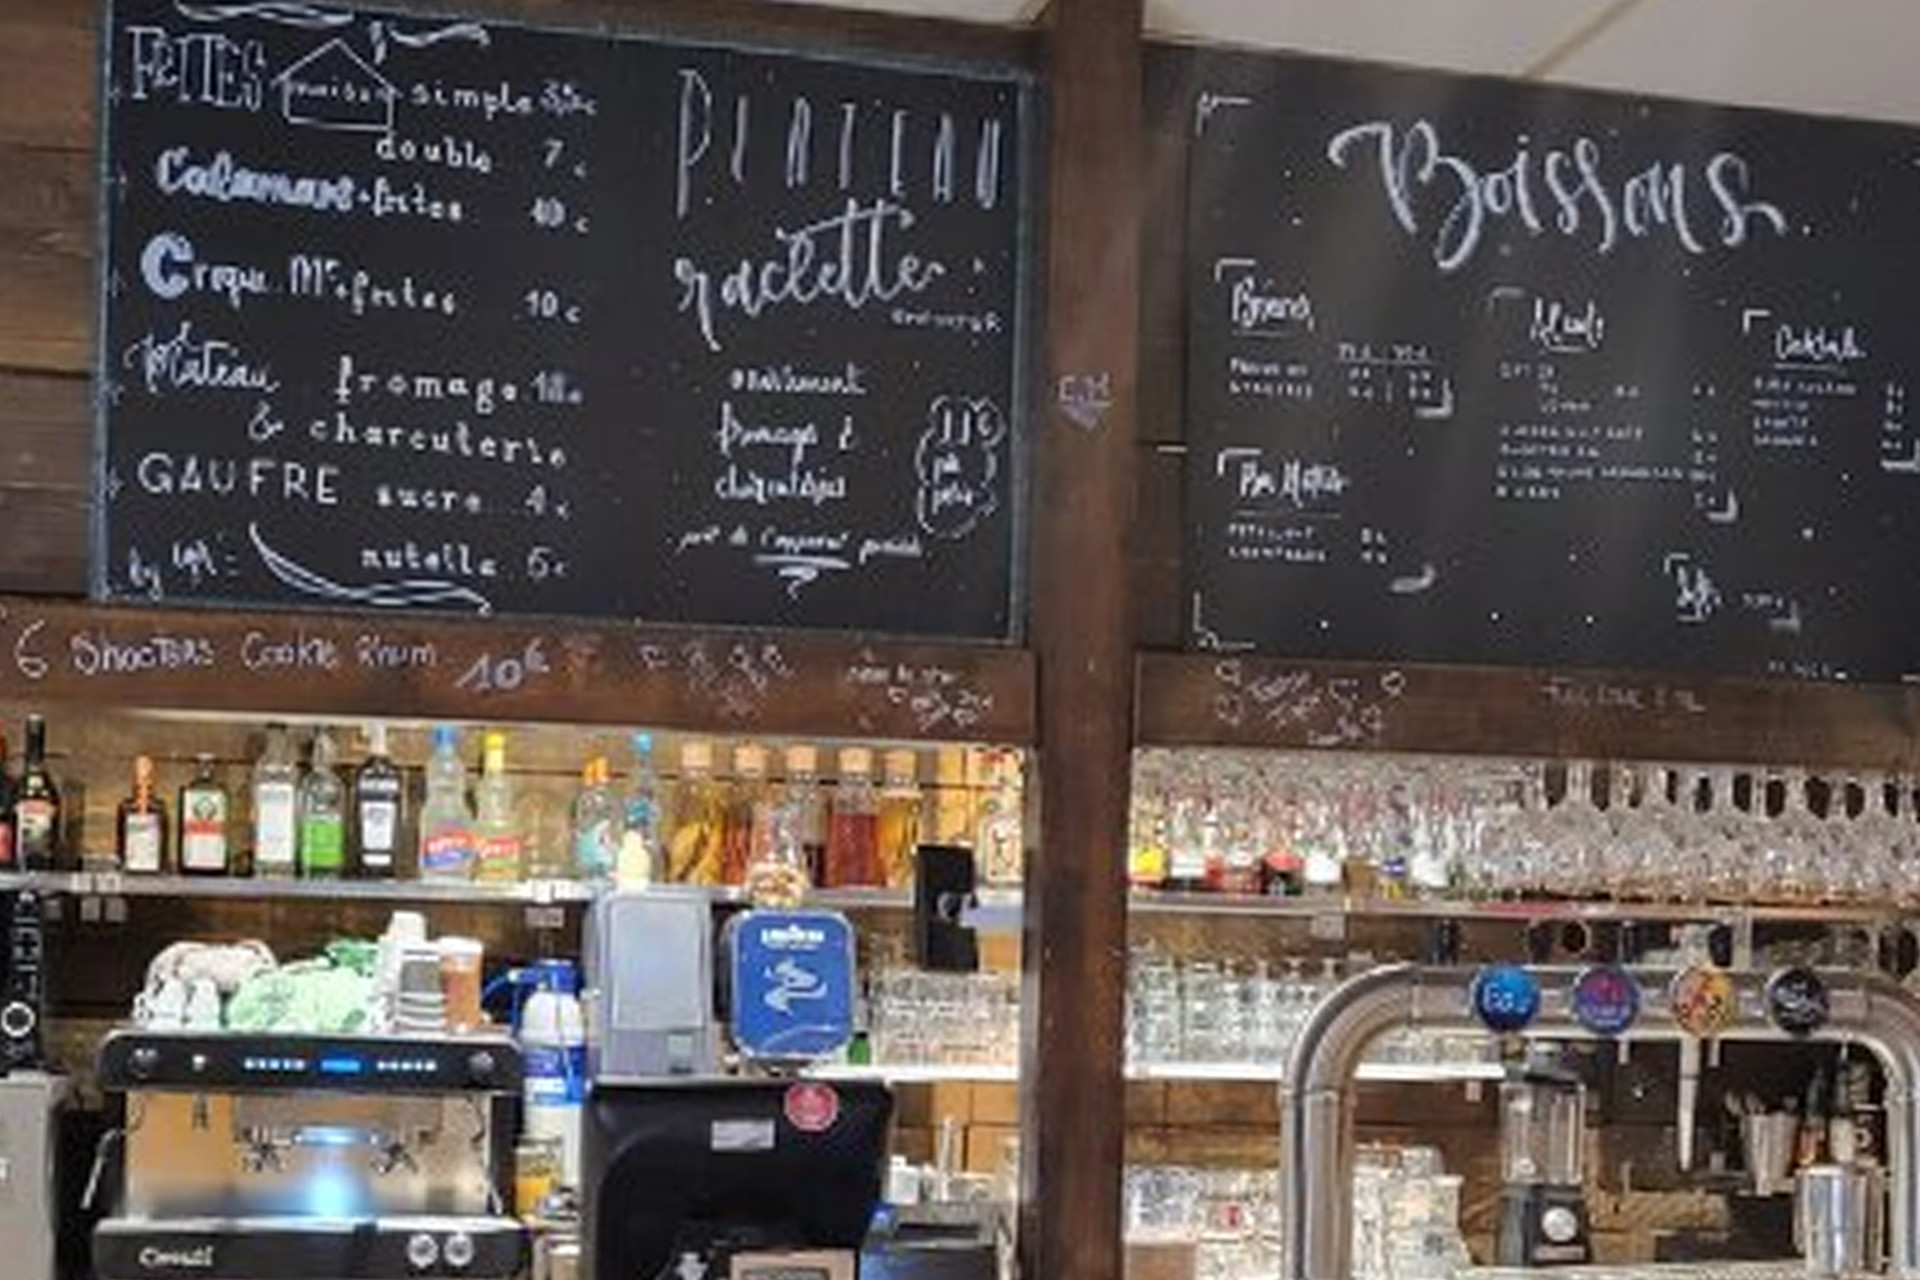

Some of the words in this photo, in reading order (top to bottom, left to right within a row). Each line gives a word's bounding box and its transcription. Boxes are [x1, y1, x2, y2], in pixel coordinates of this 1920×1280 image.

[412, 81, 532, 120] simple
[376, 138, 494, 173] double
[1327, 118, 1786, 269] Boissons
[137, 452, 341, 506] GAUFRE
